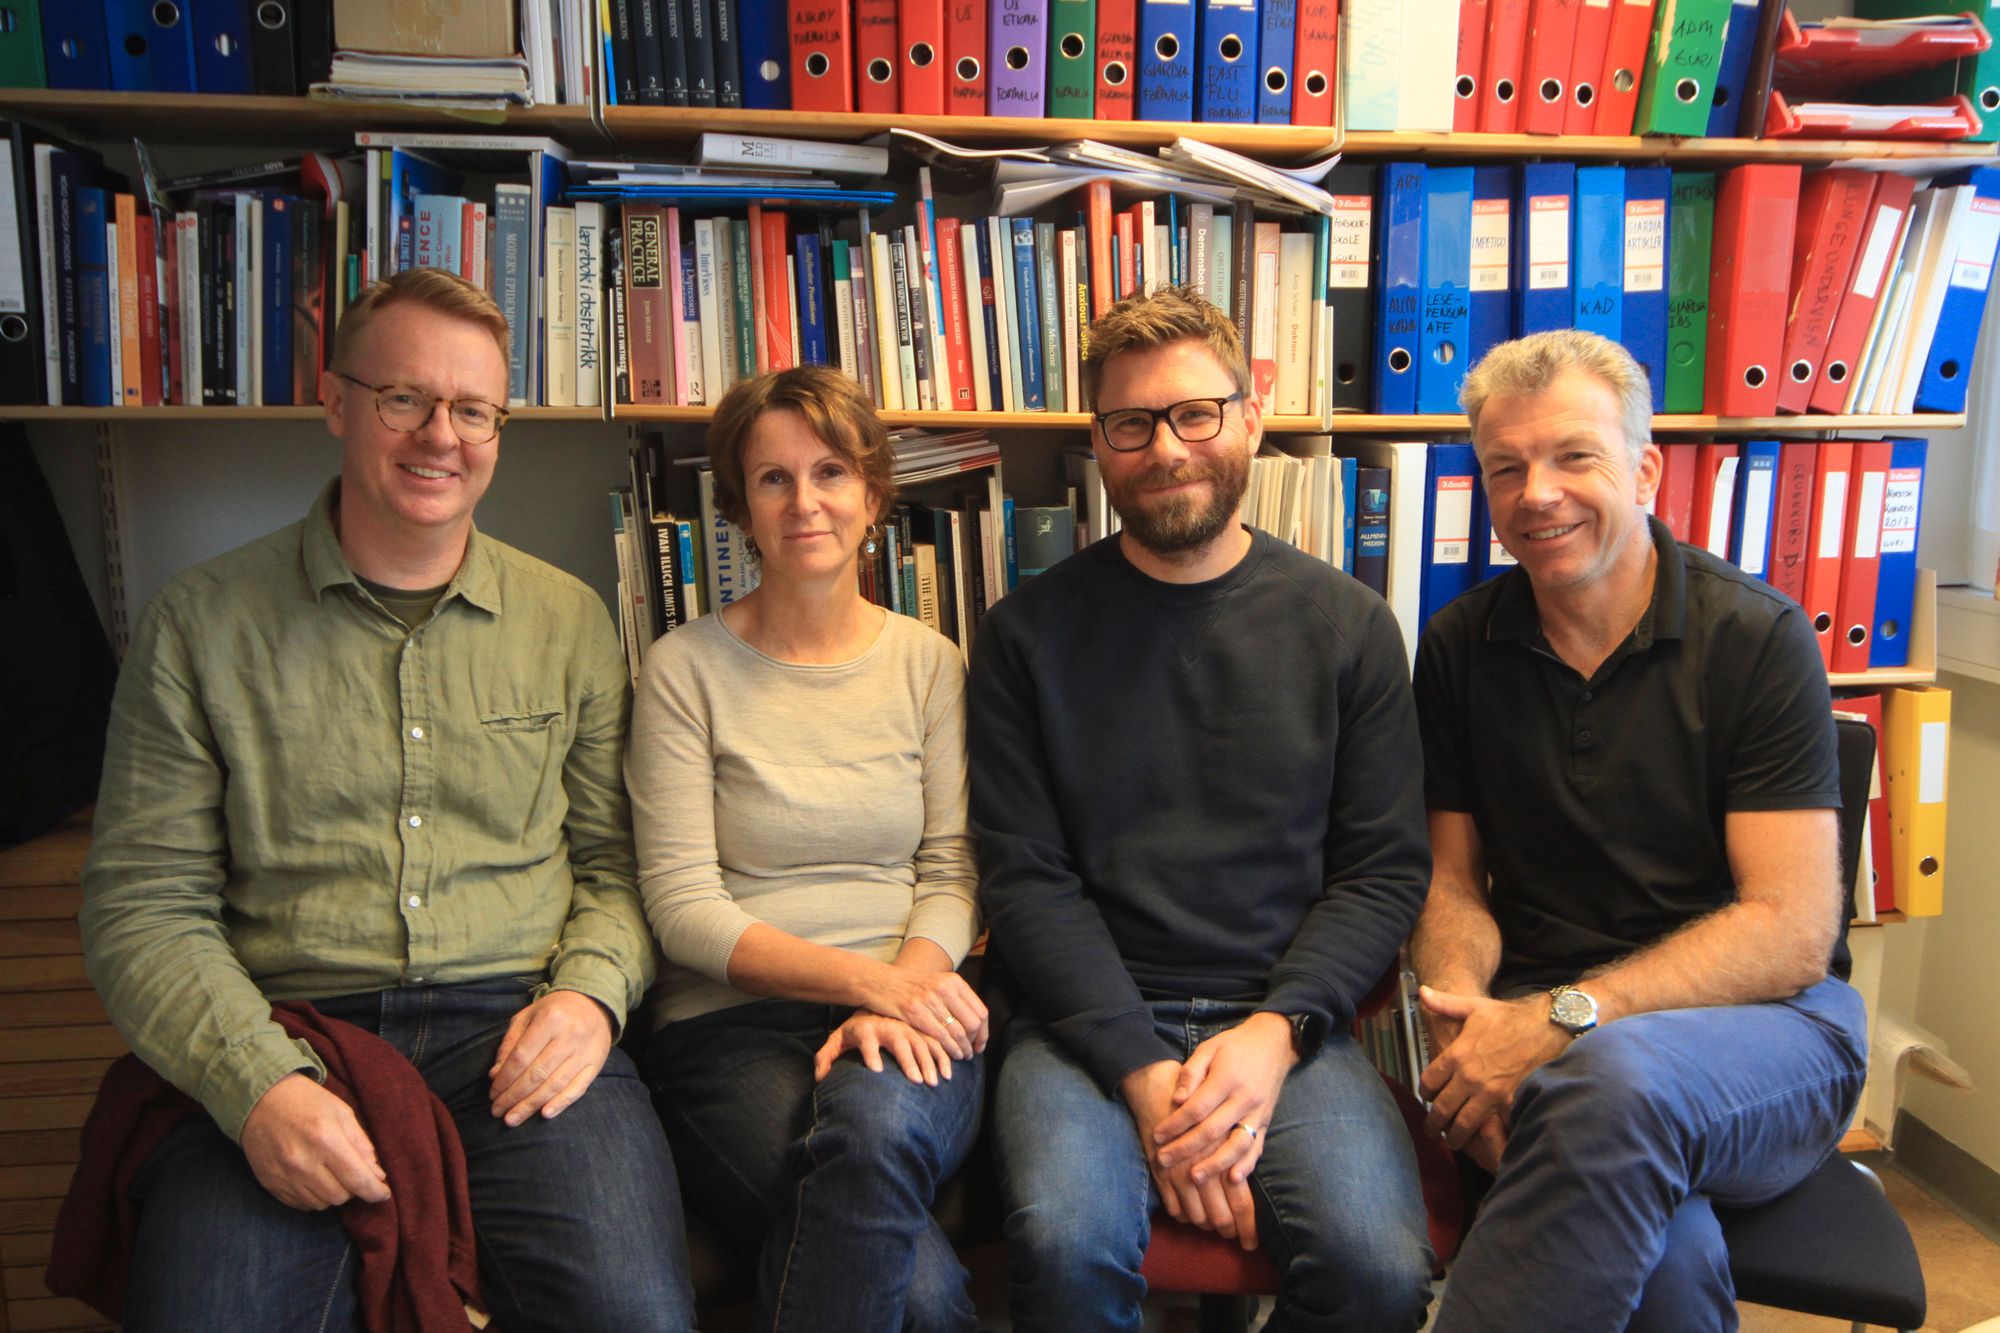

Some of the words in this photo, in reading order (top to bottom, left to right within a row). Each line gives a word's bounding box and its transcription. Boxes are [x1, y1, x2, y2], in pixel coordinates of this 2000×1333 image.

[627, 80, 631, 90] 1
[650, 77, 656, 87] 2
[675, 77, 680, 88] 3
[699, 78, 705, 89] 4
[725, 82, 730, 92] 5
[578, 226, 596, 283] lærebok
[631, 219, 645, 282] PRACTICE
[645, 221, 658, 281] GENERAL
[1198, 229, 1206, 294] Demensboka
[701, 253, 712, 296] InterViews
[686, 269, 696, 316] Depression
[1078, 284, 1088, 323] Anxious
[1239, 279, 1247, 317] OBSTETRIKK
[1046, 298, 1056, 325] Family
[580, 293, 597, 369] obstetrikk
[1048, 328, 1057, 367] Medicine
[658, 528, 669, 553] IVAN
[661, 556, 673, 587] ILLICH
[664, 589, 675, 617] LIMITS
[667, 619, 677, 631] TO
